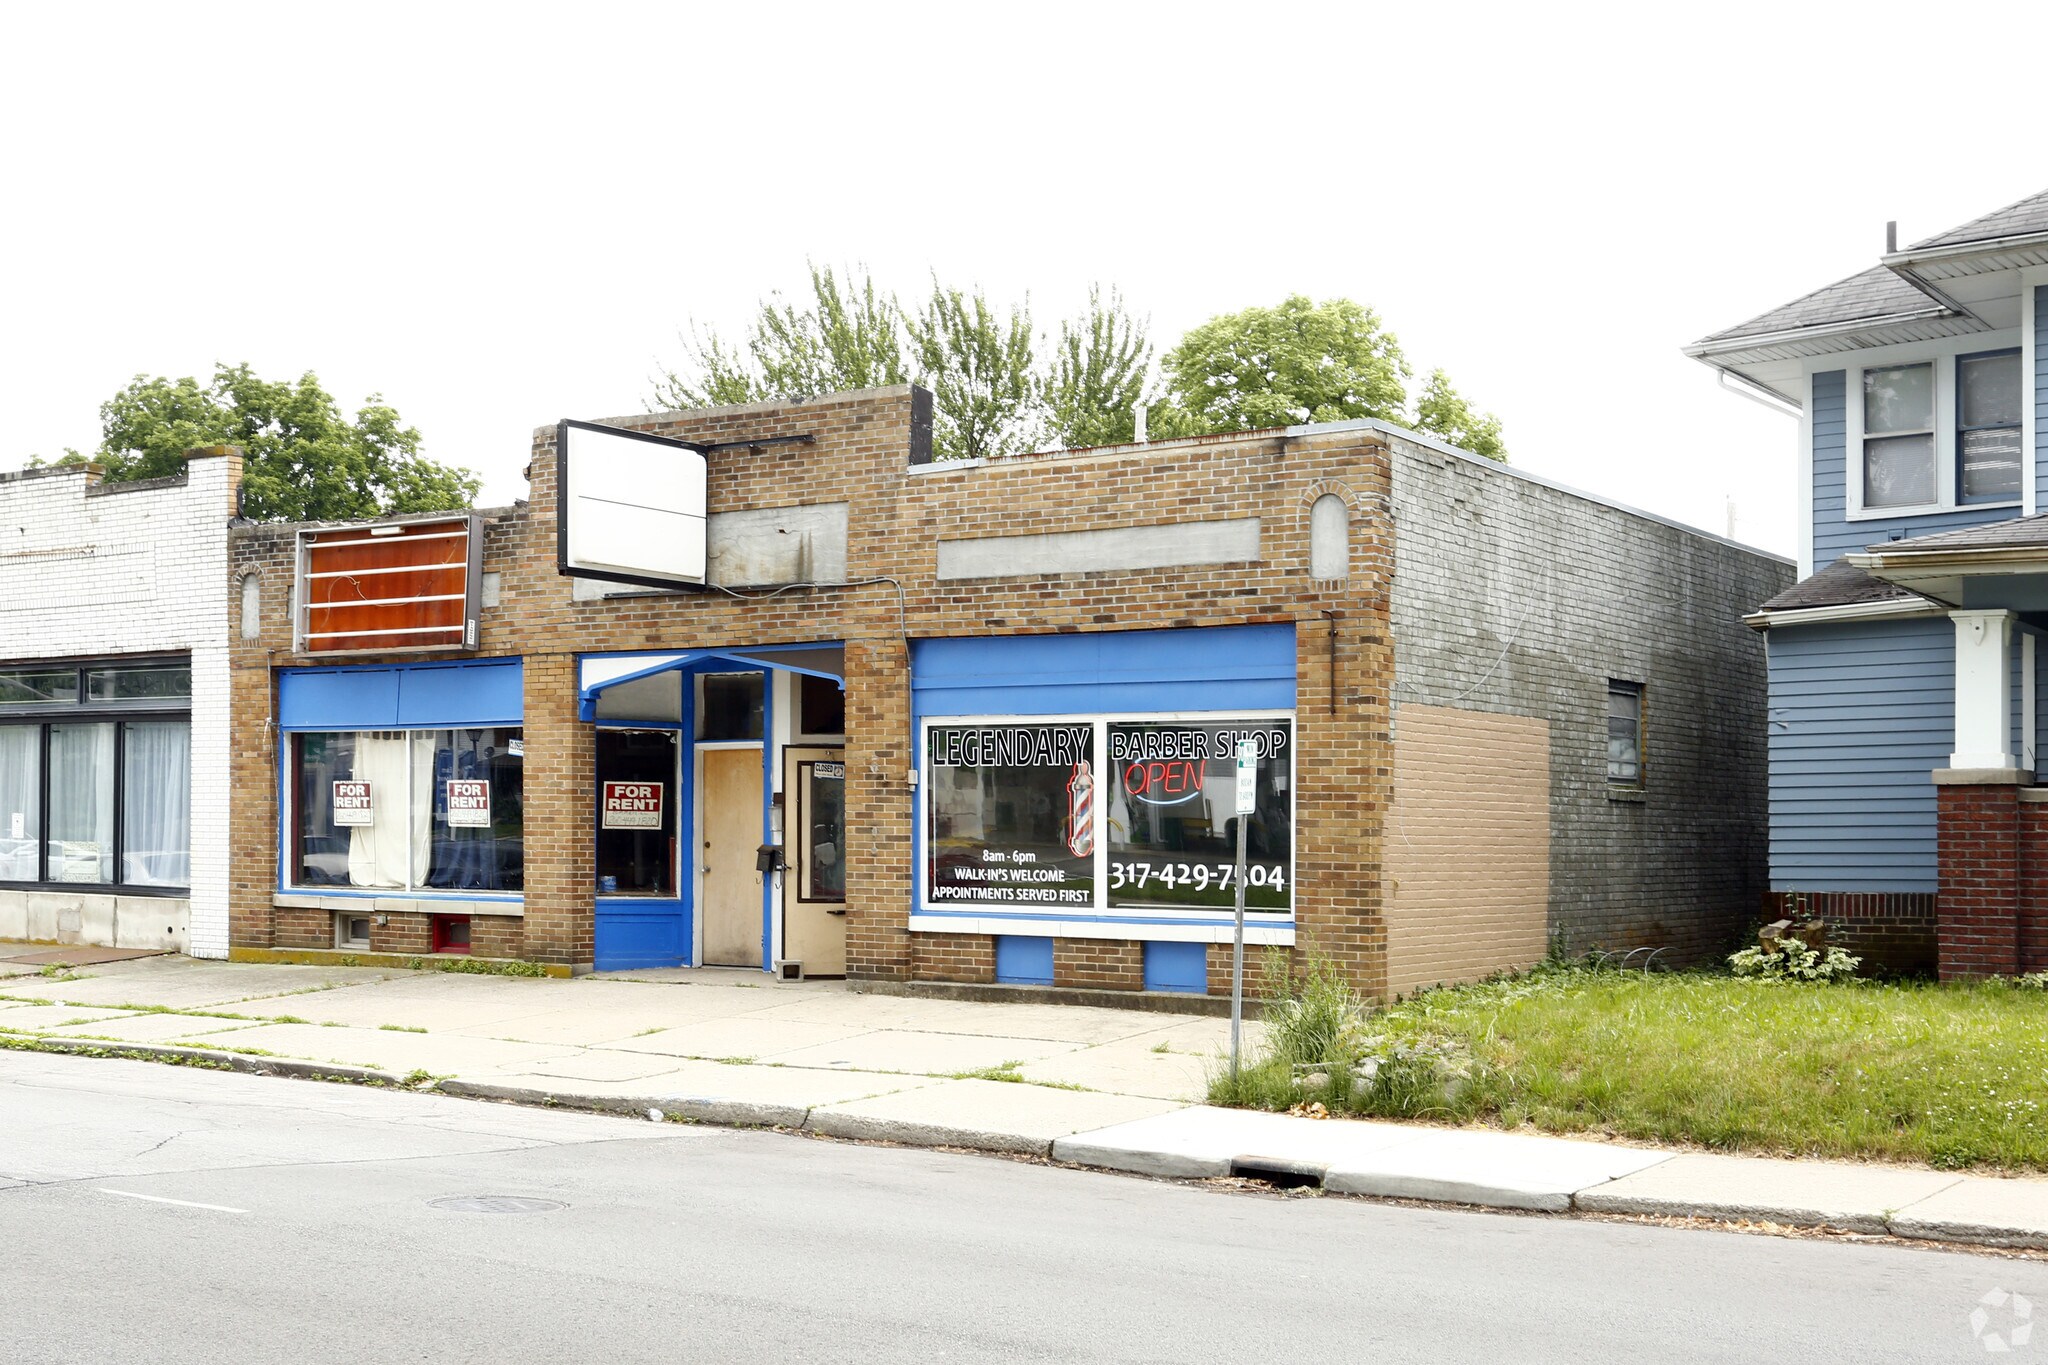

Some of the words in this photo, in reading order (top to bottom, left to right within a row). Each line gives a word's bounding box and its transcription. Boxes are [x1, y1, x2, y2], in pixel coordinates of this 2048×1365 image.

[932, 728, 1089, 767] LEGENDARY
[1111, 731, 1209, 760] BARBER
[815, 763, 834, 773] CLOSED
[1125, 760, 1206, 795] OPEN
[339, 784, 366, 797] FOR
[454, 784, 482, 797] FOR
[614, 785, 652, 798] FOR
[336, 796, 370, 808] RENT
[450, 796, 486, 808] RENT
[608, 798, 658, 810] RENT
[982, 849, 1005, 862] 8am
[1012, 849, 1036, 865] 6pm
[954, 868, 1008, 881] WALK-IN'S
[1010, 869, 1065, 882] WELCOME
[932, 886, 1014, 900] APPOINTMENTS
[1015, 888, 1057, 901] SERVED
[1059, 889, 1090, 902] FIRST
